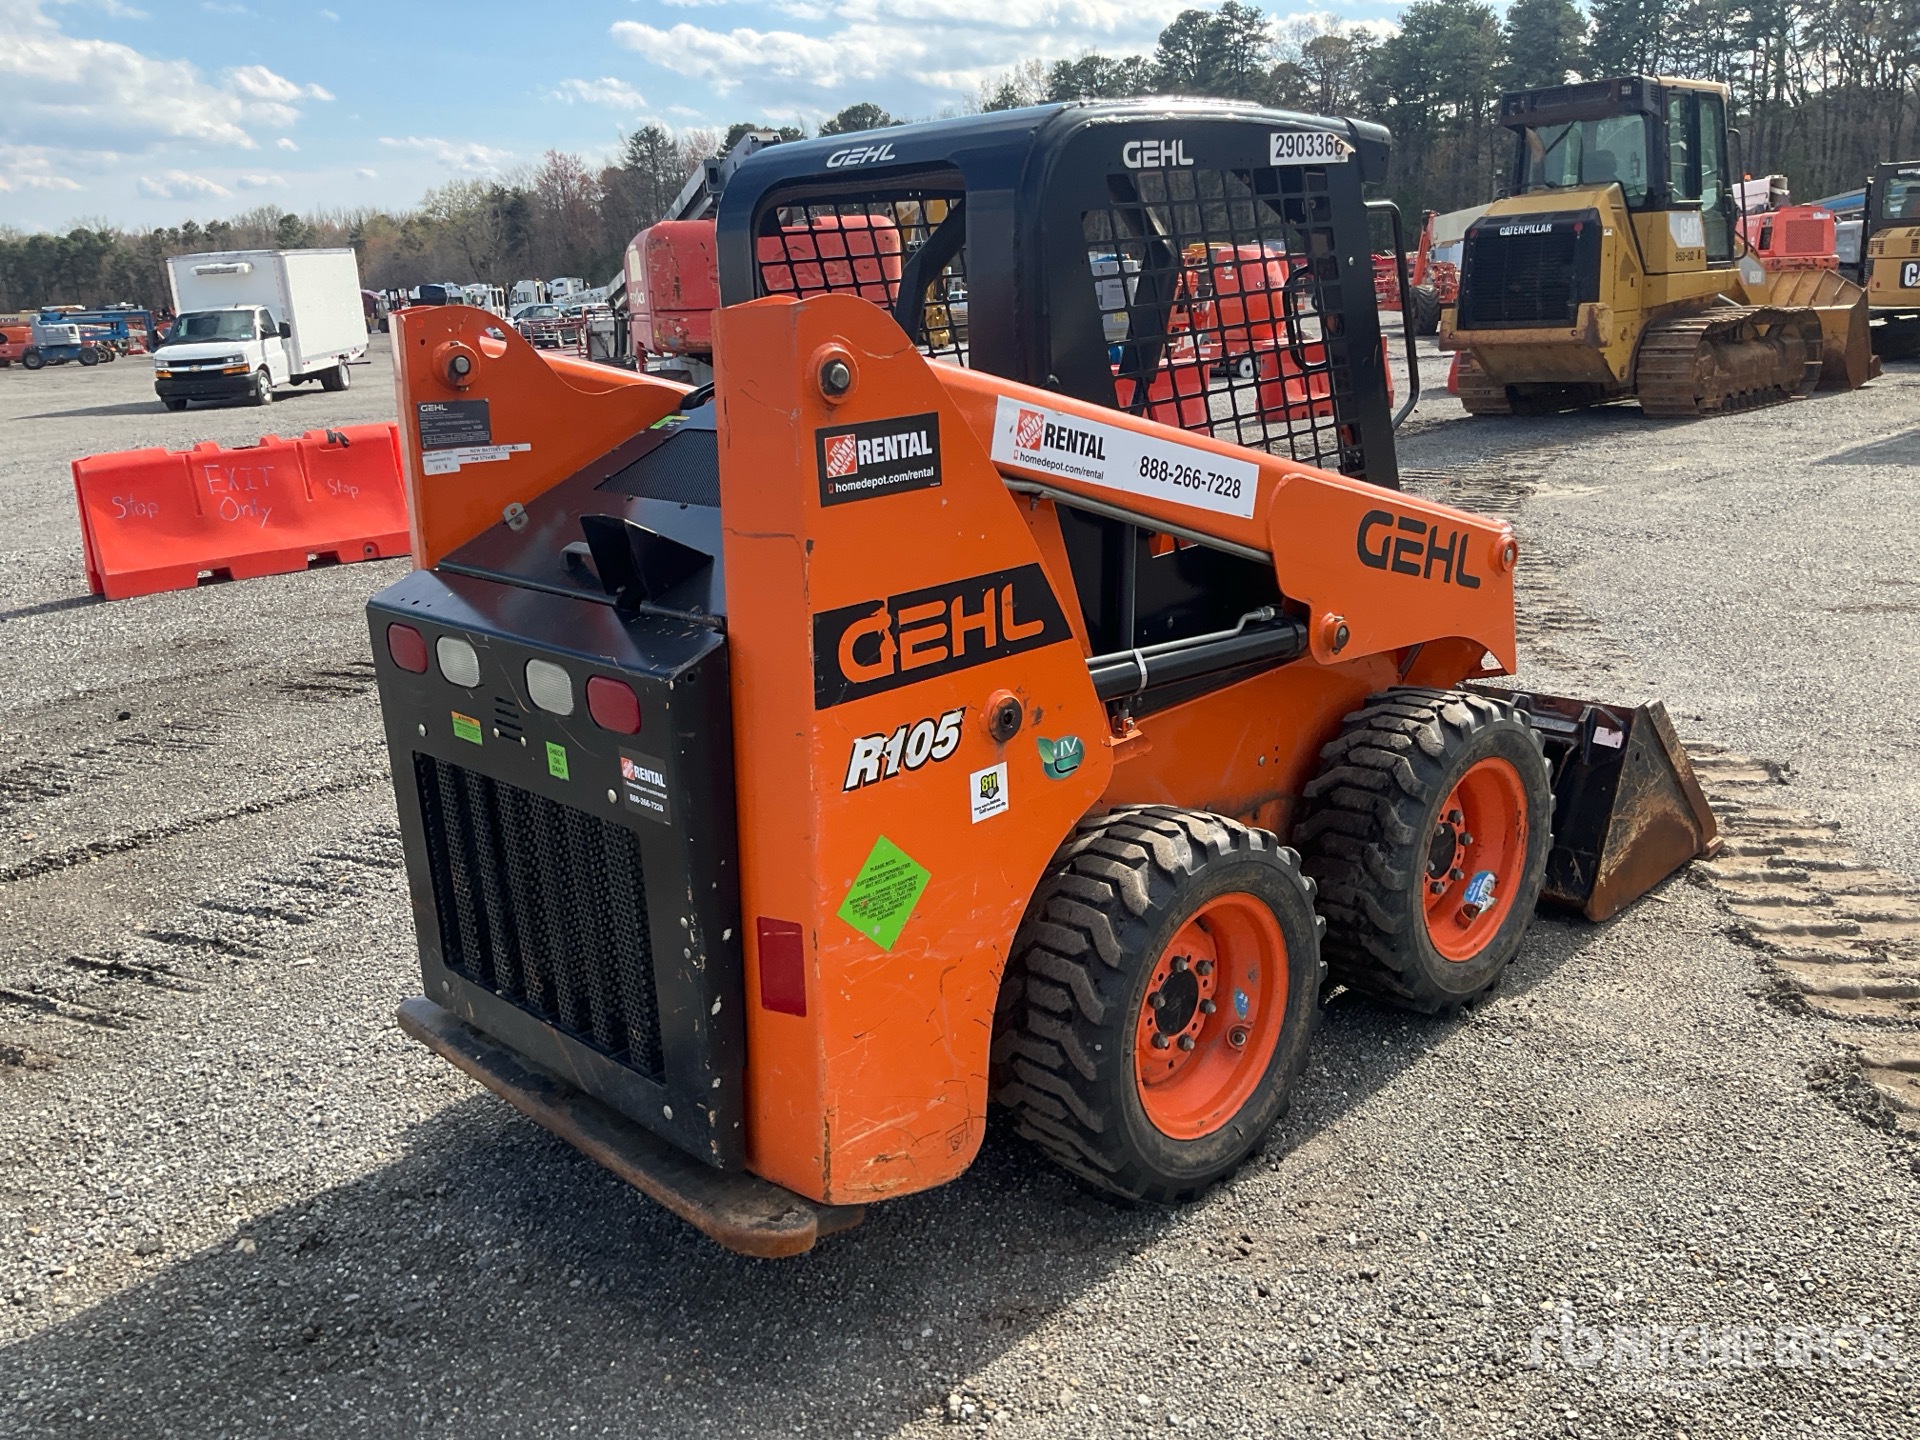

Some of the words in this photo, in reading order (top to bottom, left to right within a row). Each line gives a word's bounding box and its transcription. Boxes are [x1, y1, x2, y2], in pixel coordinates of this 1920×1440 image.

[825, 143, 896, 169] GEHL
[1122, 140, 1194, 169] GEHL
[1499, 223, 1552, 236] CATERPILLAR
[420, 404, 448, 412] GEHL
[1016, 414, 1043, 447] HOME
[1043, 422, 1106, 461] RENTAL
[827, 435, 855, 476] HOME
[839, 448, 856, 475] DEPOT
[858, 431, 932, 466] RENTAL
[204, 464, 274, 495] EXIT
[835, 466, 934, 493] homedepot.com/rental
[1019, 451, 1104, 480] homedepot.com/rental
[1139, 455, 1242, 499] 888-266-7228
[326, 478, 359, 498] Stop
[112, 494, 159, 520] Stop
[219, 496, 272, 528] Only
[1357, 510, 1481, 589] GEHL
[838, 583, 1044, 683] GEHL
[842, 707, 966, 792] R105
[634, 765, 666, 788] RENTAL
[981, 772, 998, 792] 811
[629, 794, 664, 812] 888-266-7228
